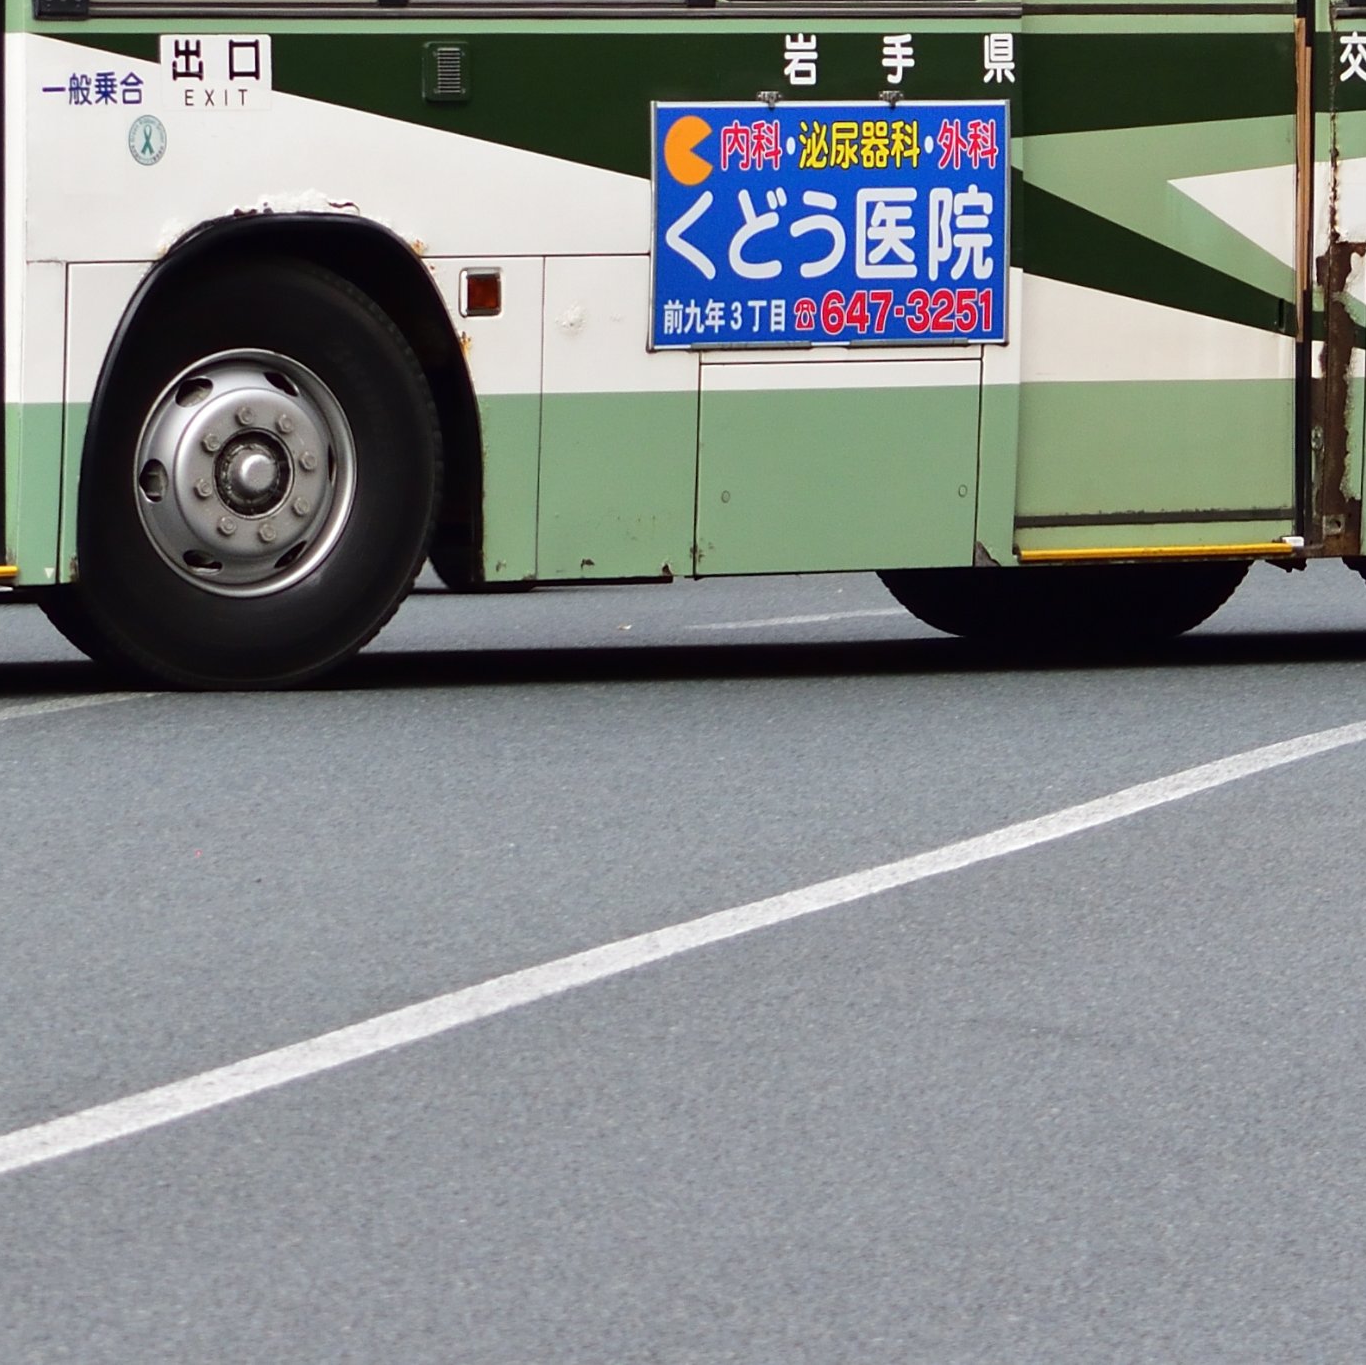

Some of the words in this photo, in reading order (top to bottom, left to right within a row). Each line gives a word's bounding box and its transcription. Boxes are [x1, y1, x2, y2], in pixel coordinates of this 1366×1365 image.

[172, 39, 261, 82] 出口
[42, 71, 144, 106] 一般乗合
[185, 89, 249, 107] EXIT
[666, 184, 994, 281] くどう医院
[821, 288, 994, 335] 647-3251
